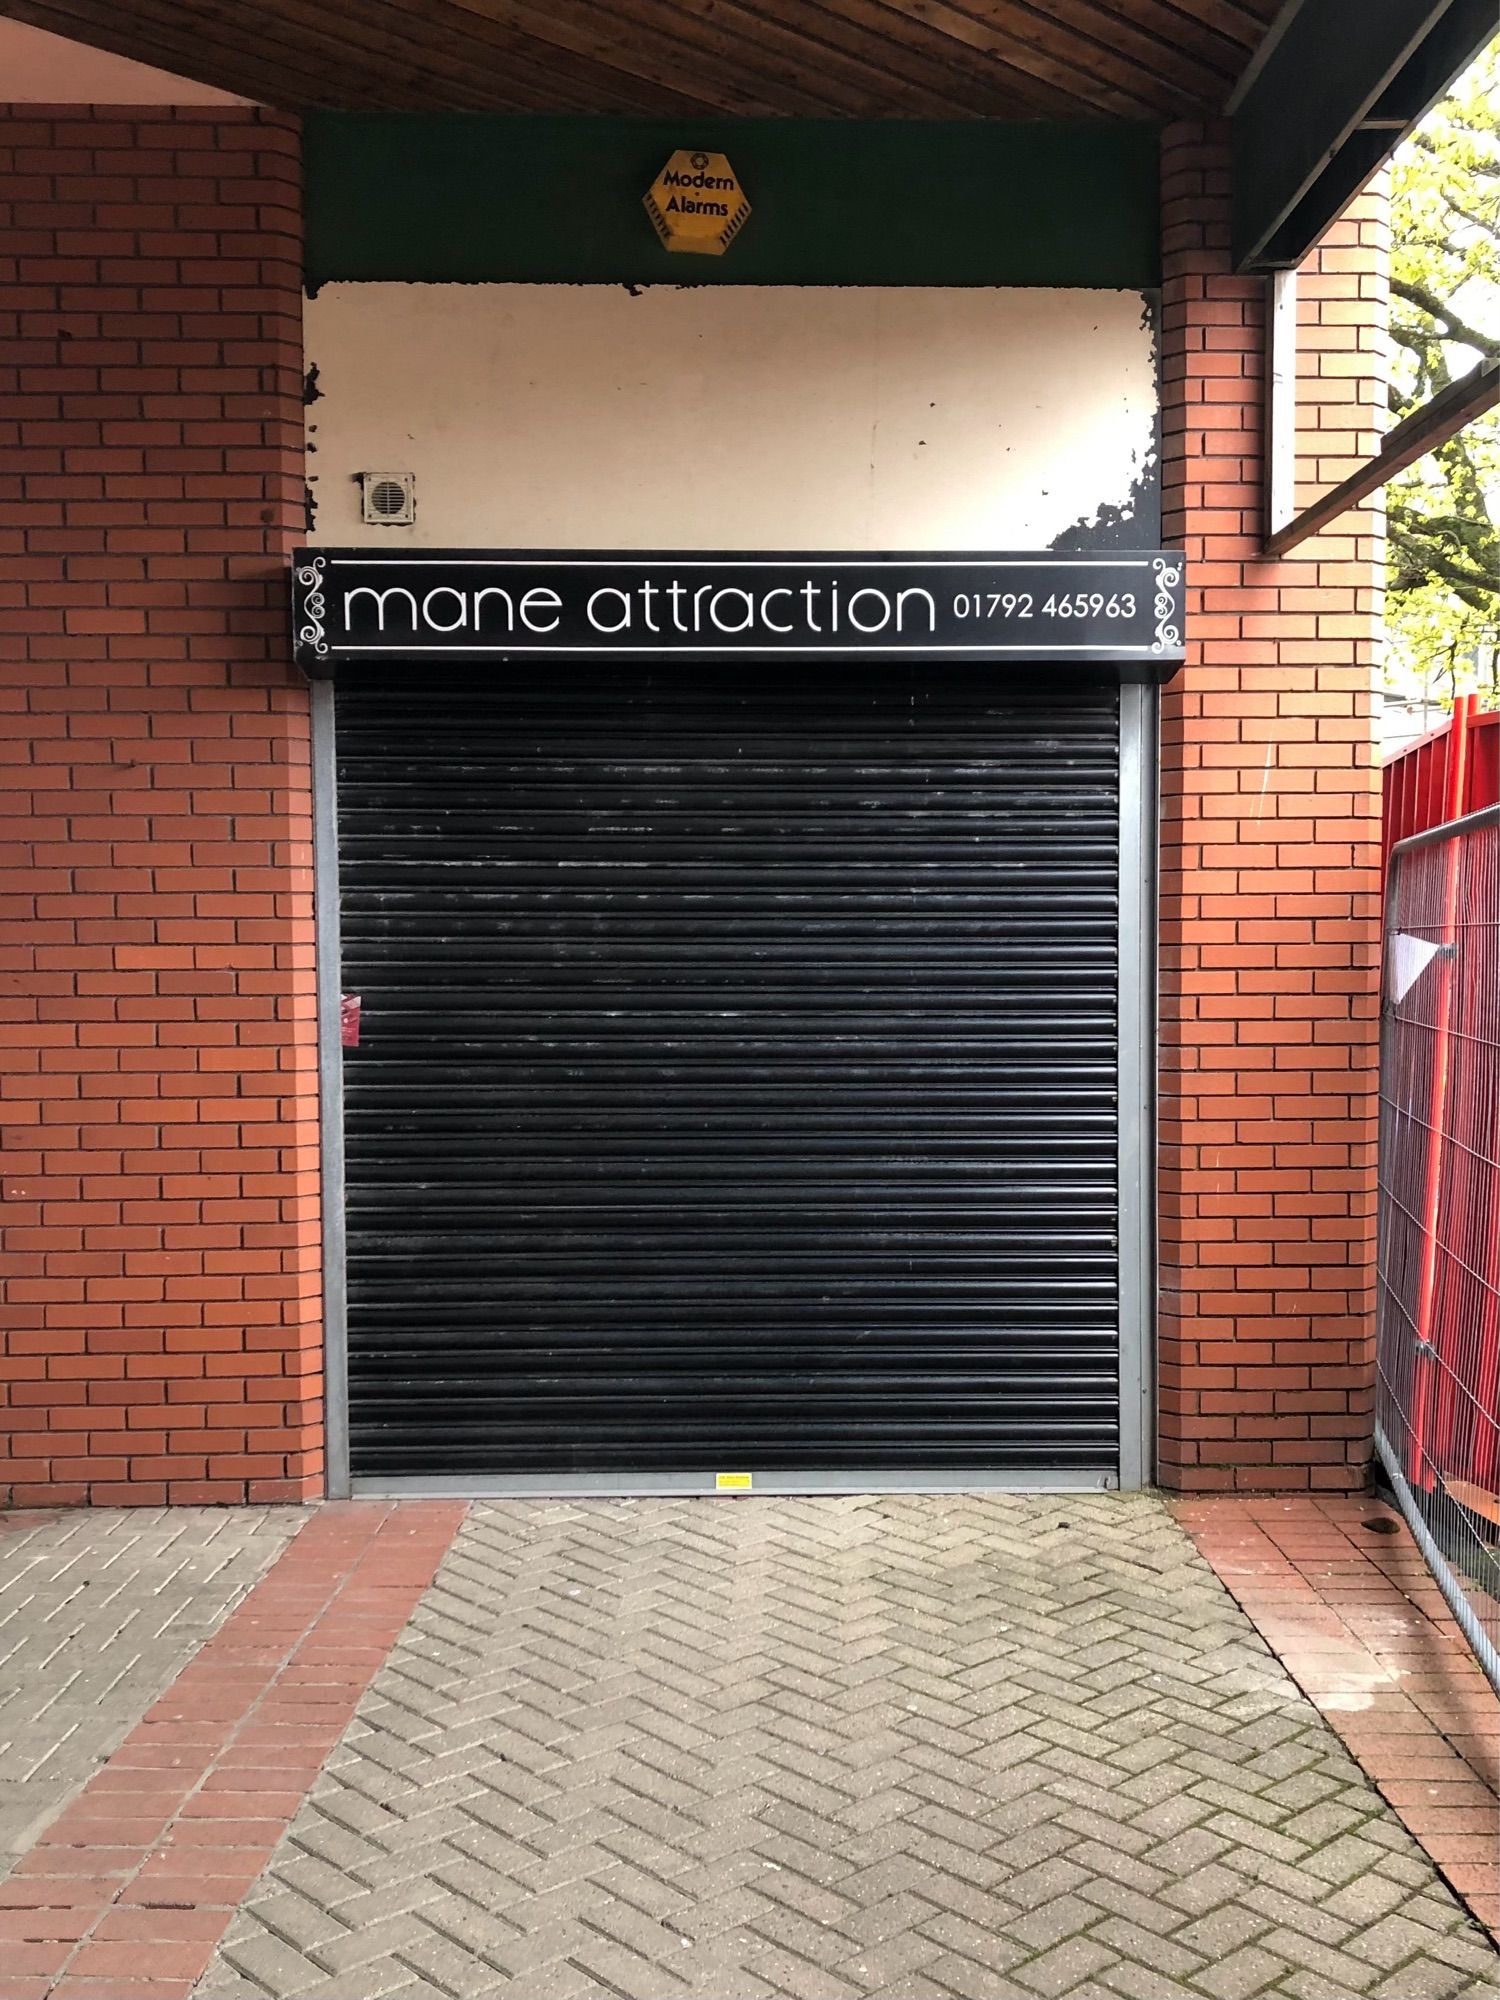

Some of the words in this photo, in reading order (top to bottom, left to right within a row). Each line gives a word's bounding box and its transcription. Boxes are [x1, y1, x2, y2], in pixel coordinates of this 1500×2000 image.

[662, 170, 735, 191] Modern
[665, 195, 729, 217] Alarms
[343, 586, 563, 633] mane
[586, 580, 937, 633] attraction
[953, 593, 1034, 619] 01792
[1041, 593, 1137, 619] 465963
